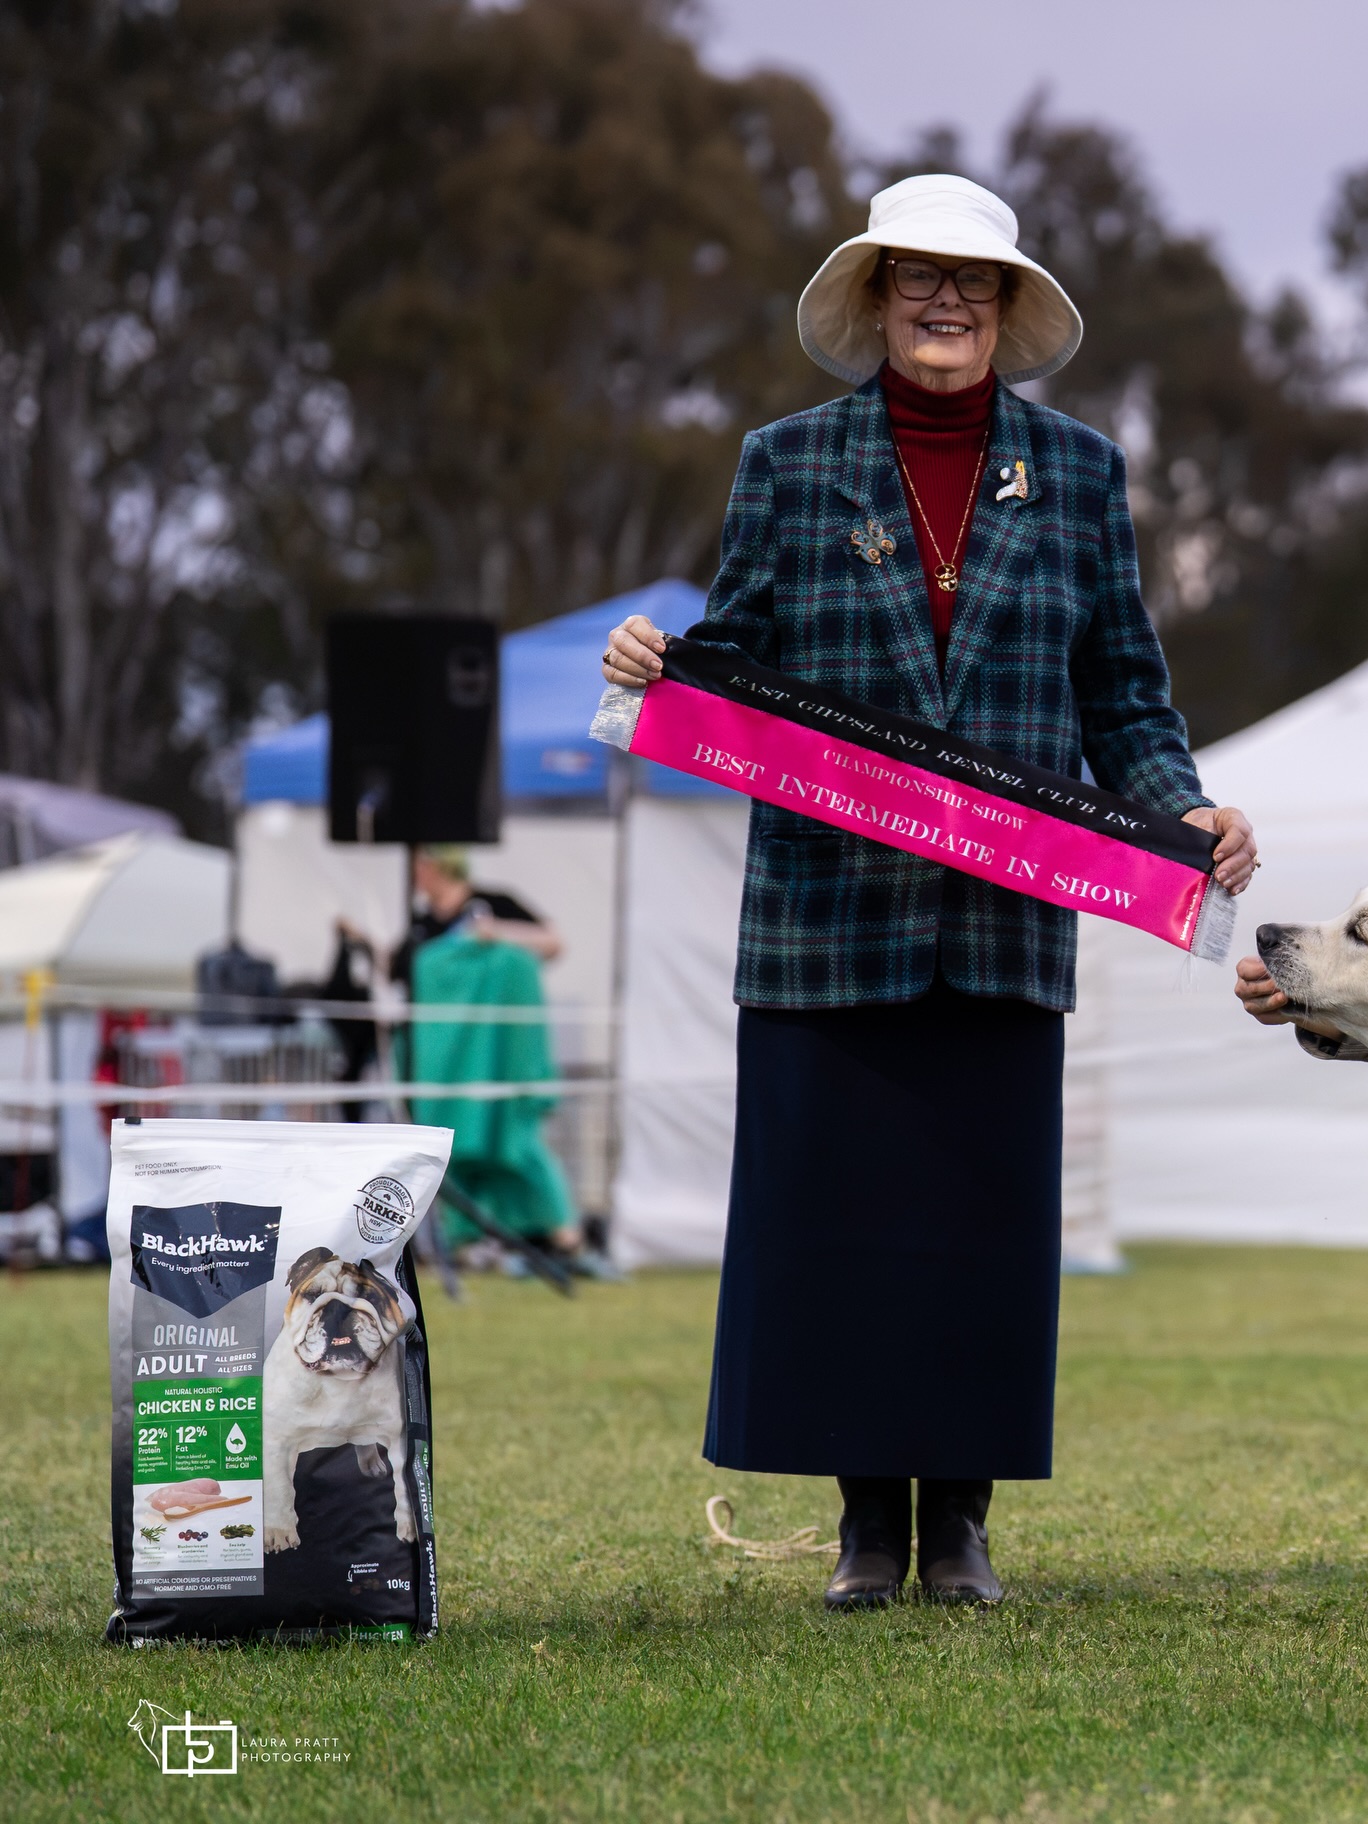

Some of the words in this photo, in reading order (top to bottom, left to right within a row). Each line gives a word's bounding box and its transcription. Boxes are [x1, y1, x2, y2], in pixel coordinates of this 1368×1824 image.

[729, 675, 790, 701] EAST
[798, 700, 927, 751] GIPPSLAND
[936, 750, 1026, 789] KENNEL
[1037, 787, 1097, 814] CLUB
[1104, 811, 1147, 830] INC
[823, 749, 969, 810] CHAMPIONSHIP
[971, 803, 1028, 831] SHOW
[692, 743, 765, 782] BEST
[776, 773, 995, 866] INTERMEDIATE
[1005, 855, 1040, 880] IN
[1051, 872, 1138, 910] SHOW
[369, 1180, 393, 1189] PROUDLY
[394, 1185, 408, 1199] MADE
[405, 1200, 410, 1208] IN
[363, 1197, 406, 1225] PARKES
[369, 1218, 383, 1227] NSW
[142, 1233, 265, 1256] BlackHawk
[152, 1257, 174, 1272] Every
[176, 1262, 216, 1274] ingredient
[216, 1260, 249, 1268] matters
[154, 1324, 239, 1347] ORIGINAL
[137, 1354, 207, 1376] ADULT
[230, 1353, 256, 1361] BREEDS
[165, 1388, 192, 1396] NATURAL
[138, 1399, 201, 1415] CHICKEN
[205, 1399, 215, 1411] &
[220, 1397, 256, 1411] RICE
[138, 1427, 168, 1446] 22%
[176, 1426, 207, 1443] 12%
[138, 1446, 160, 1455] Protein
[420, 1480, 430, 1522] ADULT
[387, 1579, 411, 1591] 10kg
